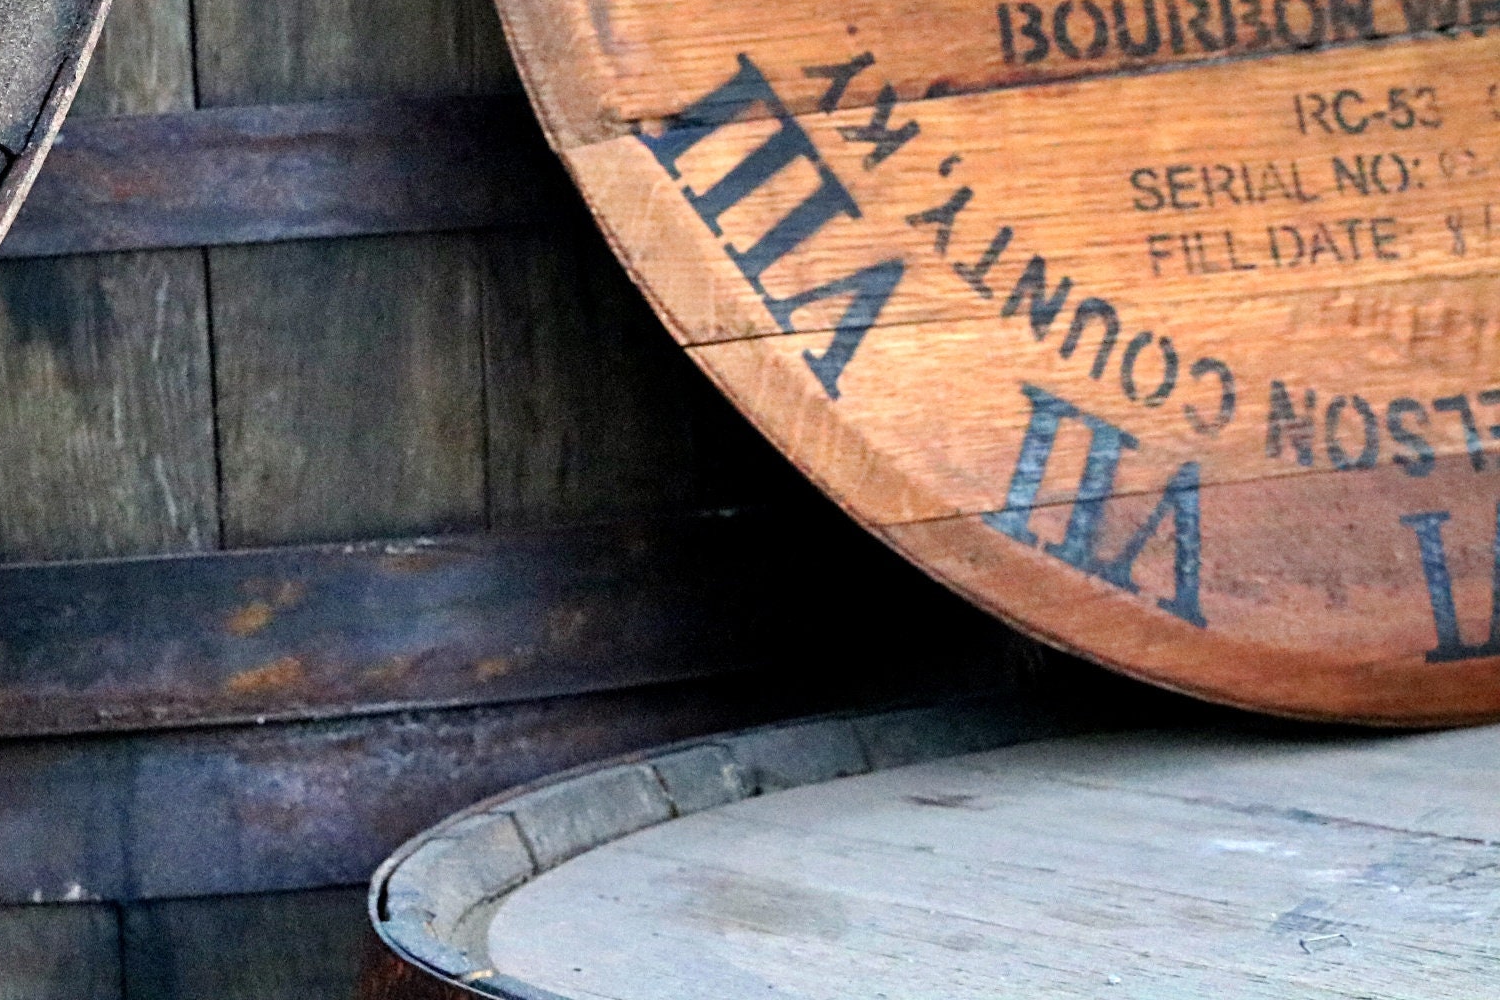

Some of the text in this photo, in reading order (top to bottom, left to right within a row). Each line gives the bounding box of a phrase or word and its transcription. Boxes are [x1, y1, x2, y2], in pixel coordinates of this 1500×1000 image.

[1292, 86, 1445, 136] RC-53
[1129, 161, 1322, 212] SERIAL
[1332, 152, 1426, 196] NO:
[1147, 229, 1257, 278] FILL
